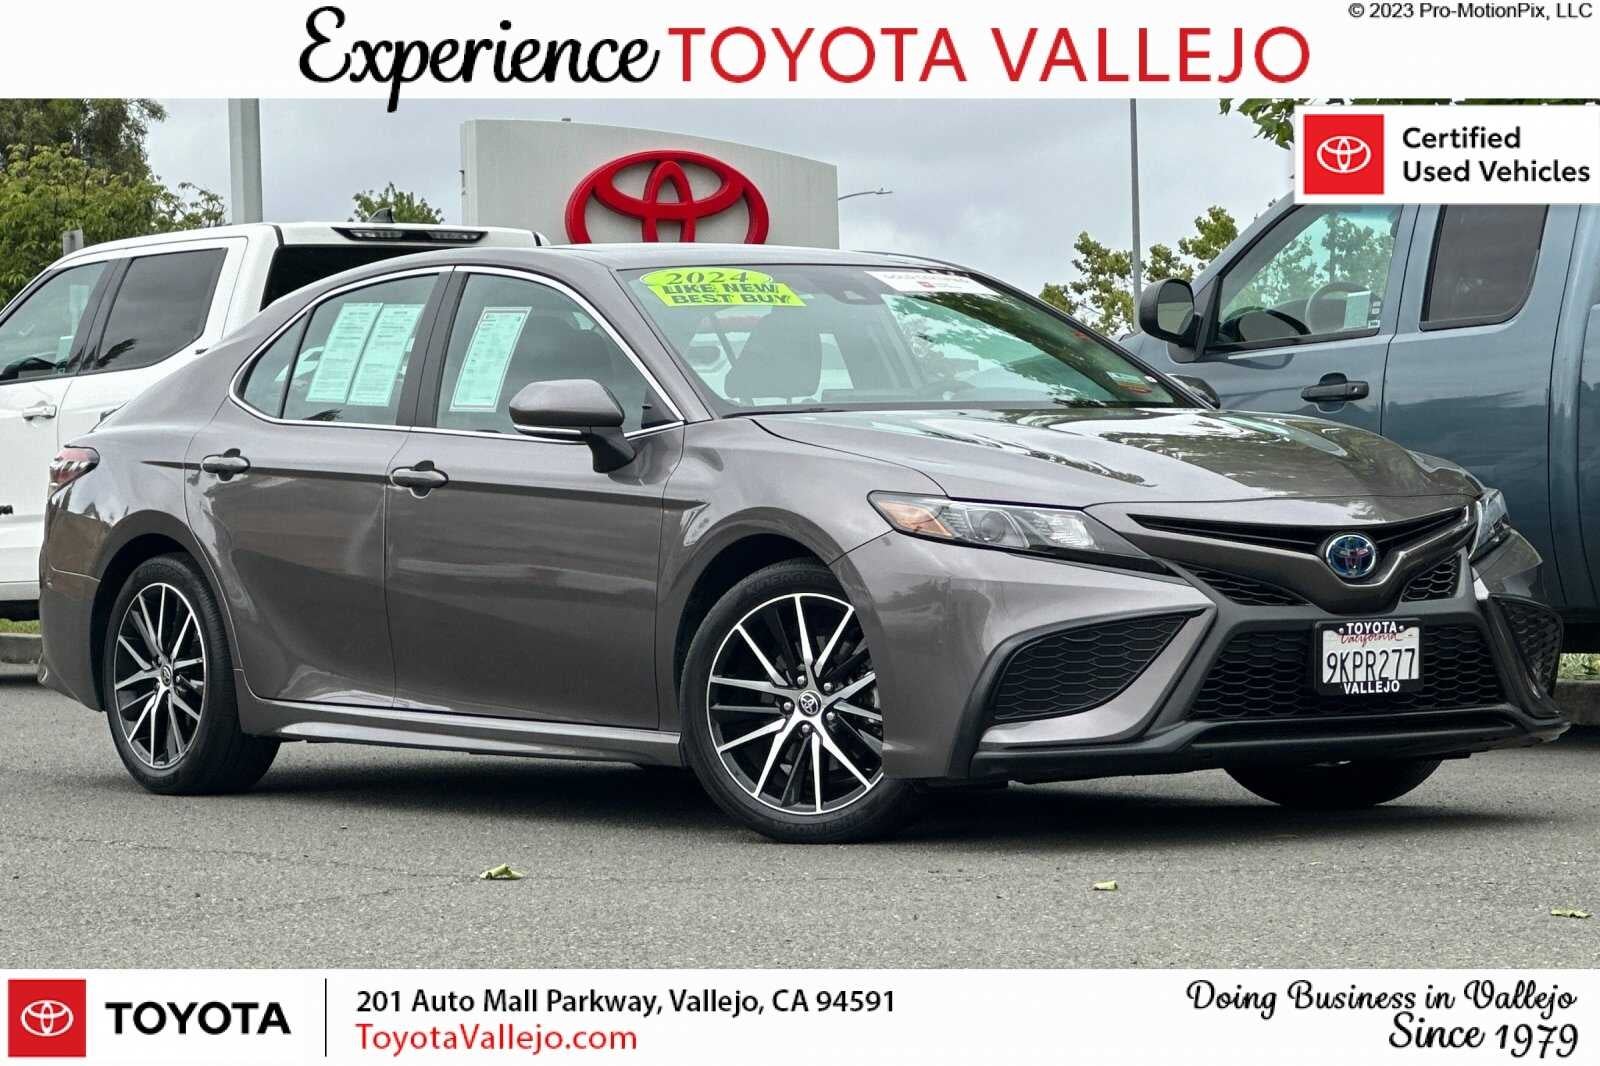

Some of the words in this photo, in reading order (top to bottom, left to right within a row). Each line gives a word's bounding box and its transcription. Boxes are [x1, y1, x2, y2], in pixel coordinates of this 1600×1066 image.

[665, 271, 748, 285] 2024
[662, 284, 715, 294] LIKE
[721, 283, 775, 292] NEW
[671, 294, 731, 304] BEST
[740, 294, 788, 303] BUY
[1346, 621, 1397, 635] TOYOTA
[1326, 648, 1416, 683] 9KPR277
[1343, 680, 1401, 695] VALLEJO
